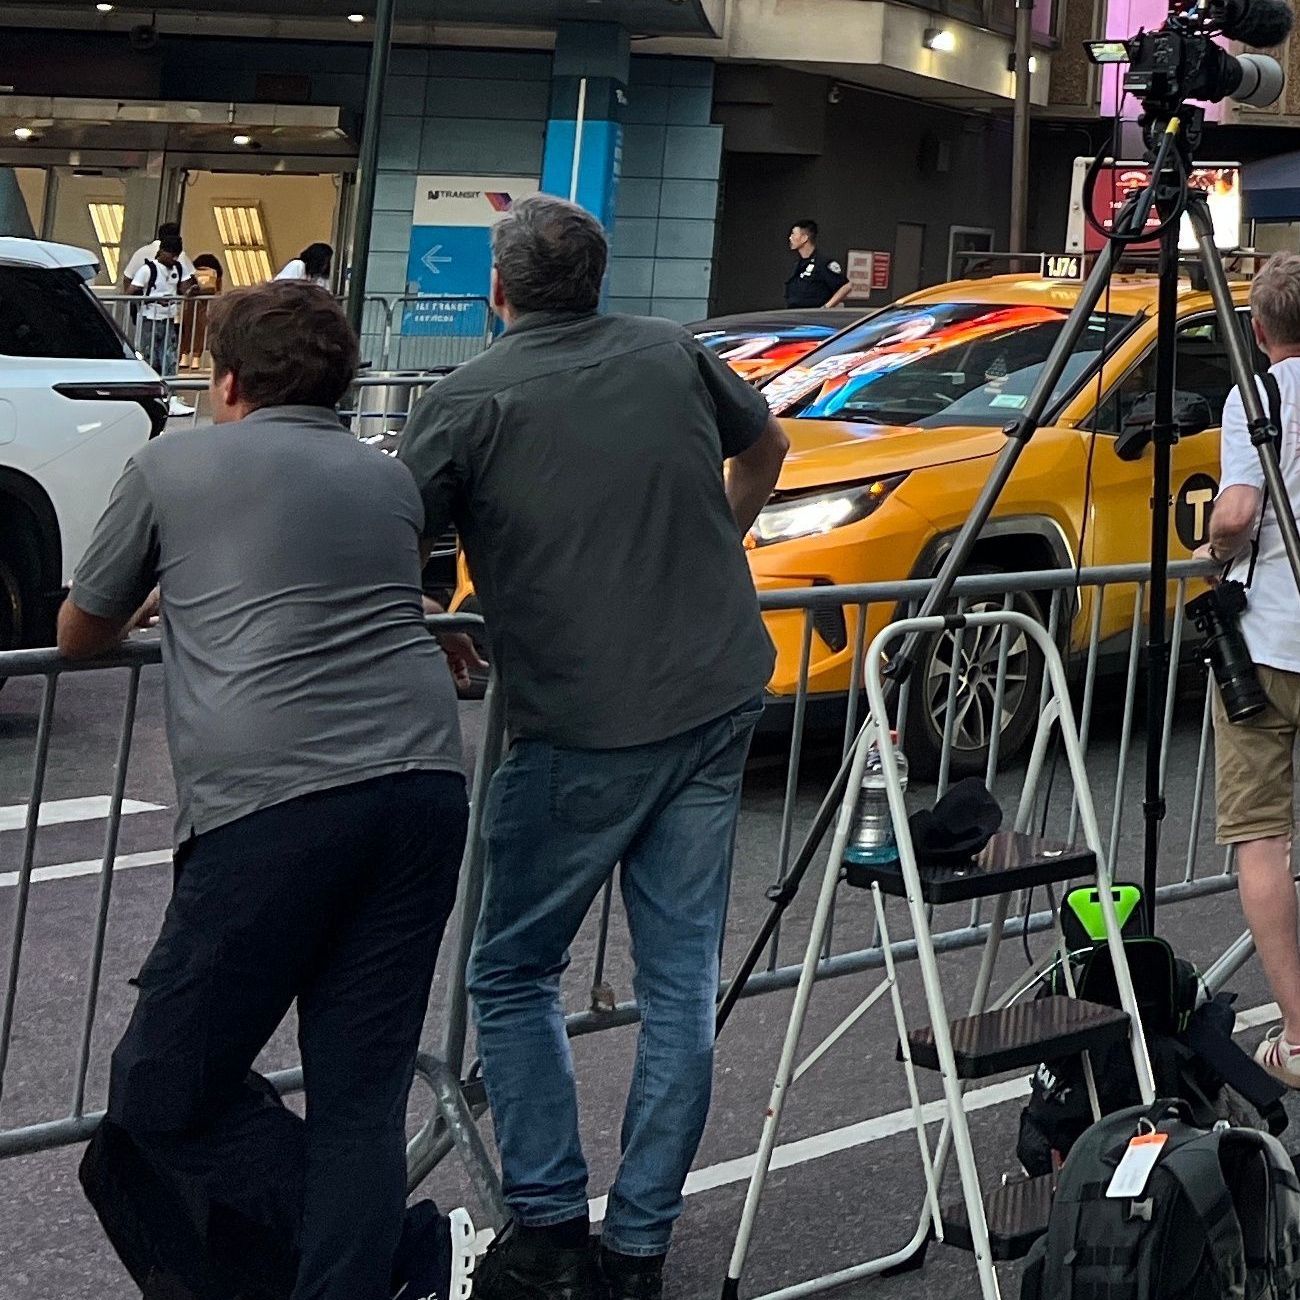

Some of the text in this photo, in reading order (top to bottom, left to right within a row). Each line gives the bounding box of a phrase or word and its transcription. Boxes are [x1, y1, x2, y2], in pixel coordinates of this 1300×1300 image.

[440, 190, 481, 200] TRANSIT
[1047, 255, 1078, 277] 1J76
[1185, 487, 1213, 541] T
